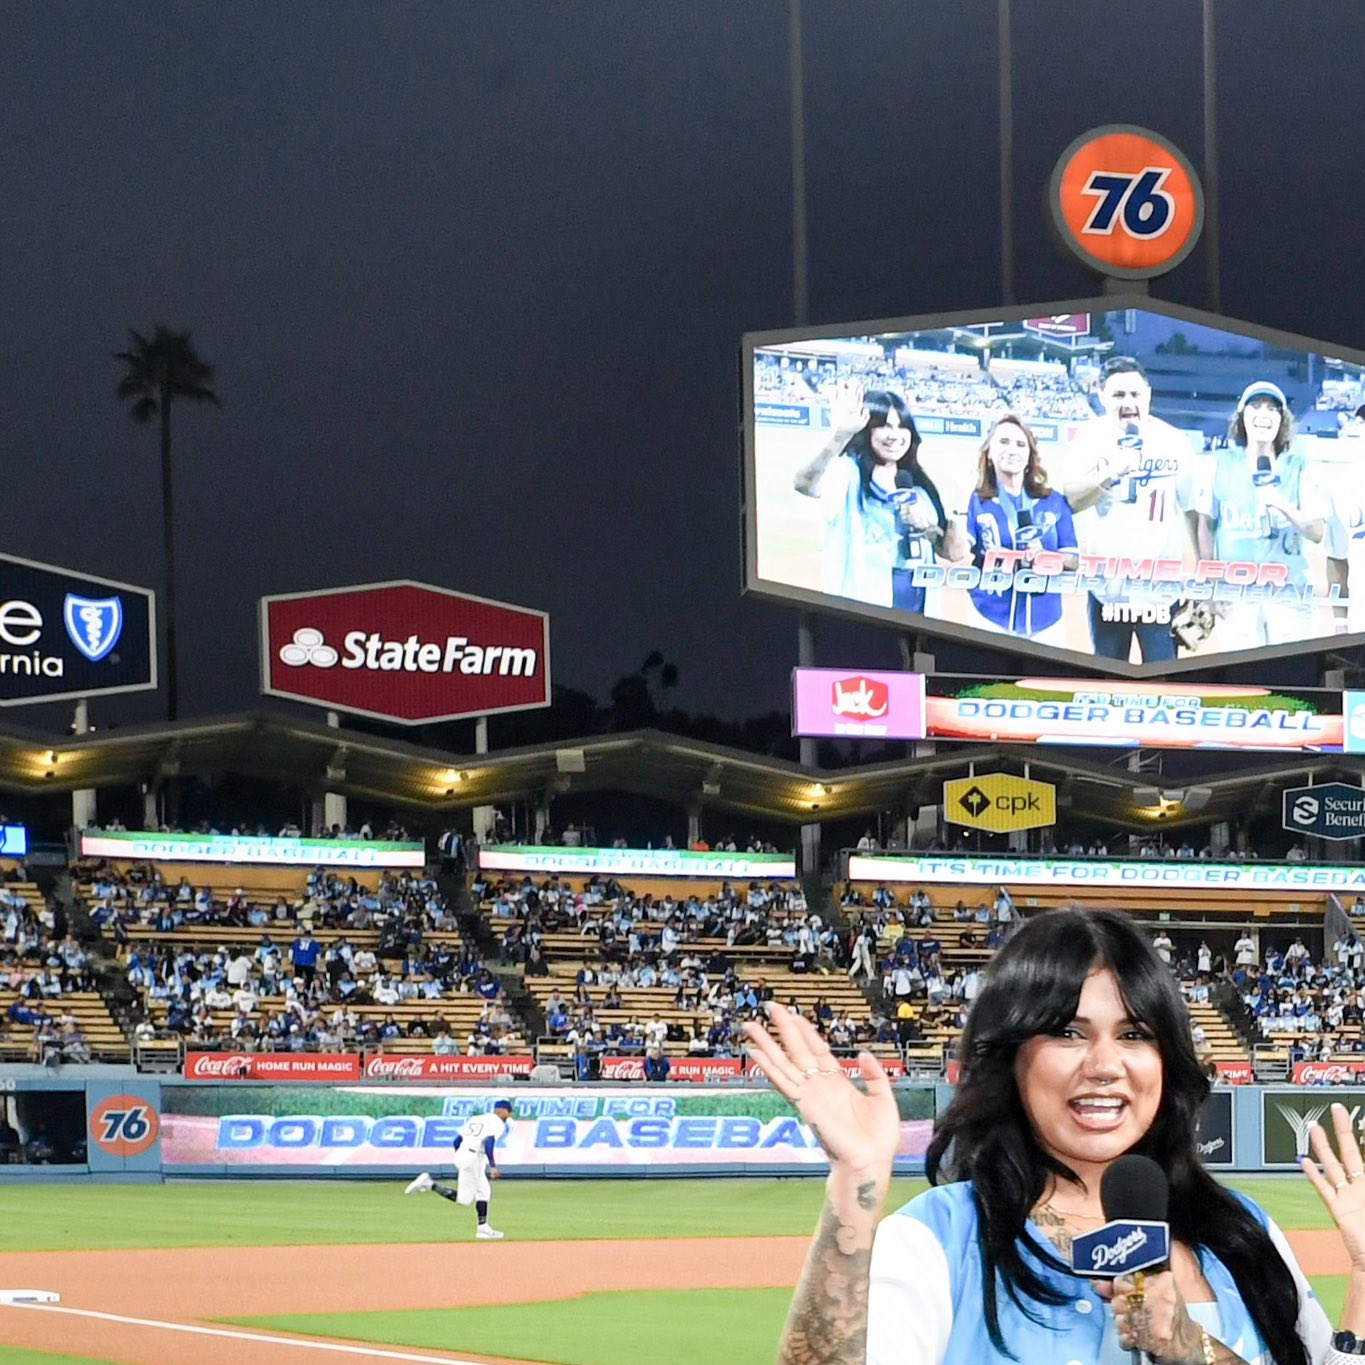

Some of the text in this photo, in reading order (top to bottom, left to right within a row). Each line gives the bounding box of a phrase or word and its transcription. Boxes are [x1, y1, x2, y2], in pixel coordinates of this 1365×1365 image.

[1080, 166, 1176, 241] 76
[1148, 489, 1165, 523] 11
[981, 549, 1288, 586] IT'S TIME FOR
[911, 564, 1352, 607] DODGER BASEBALL
[1101, 601, 1172, 627] #ITFDB
[831, 679, 888, 718] Jack
[957, 699, 1323, 732] DODGER BASEBALL
[995, 790, 1041, 817] cpk
[918, 860, 967, 876] IT'S
[976, 863, 1044, 878] TIME
[1051, 865, 1110, 880] FOR
[1119, 867, 1241, 883] DODGER
[256, 1061, 290, 1073] HOME
[292, 1061, 315, 1073] RUN
[317, 1061, 353, 1073] MAGIC
[429, 1062, 439, 1073] A
[440, 1062, 461, 1073] HIT
[462, 1062, 499, 1074] EVERY
[501, 1062, 530, 1074] TIME
[679, 1066, 700, 1075] RUN
[702, 1066, 735, 1076] MAGIC
[99, 1105, 151, 1144] 76
[513, 1097, 601, 1119] TIME
[602, 1097, 677, 1118] FOR
[1091, 1226, 1148, 1271] Dodgers
